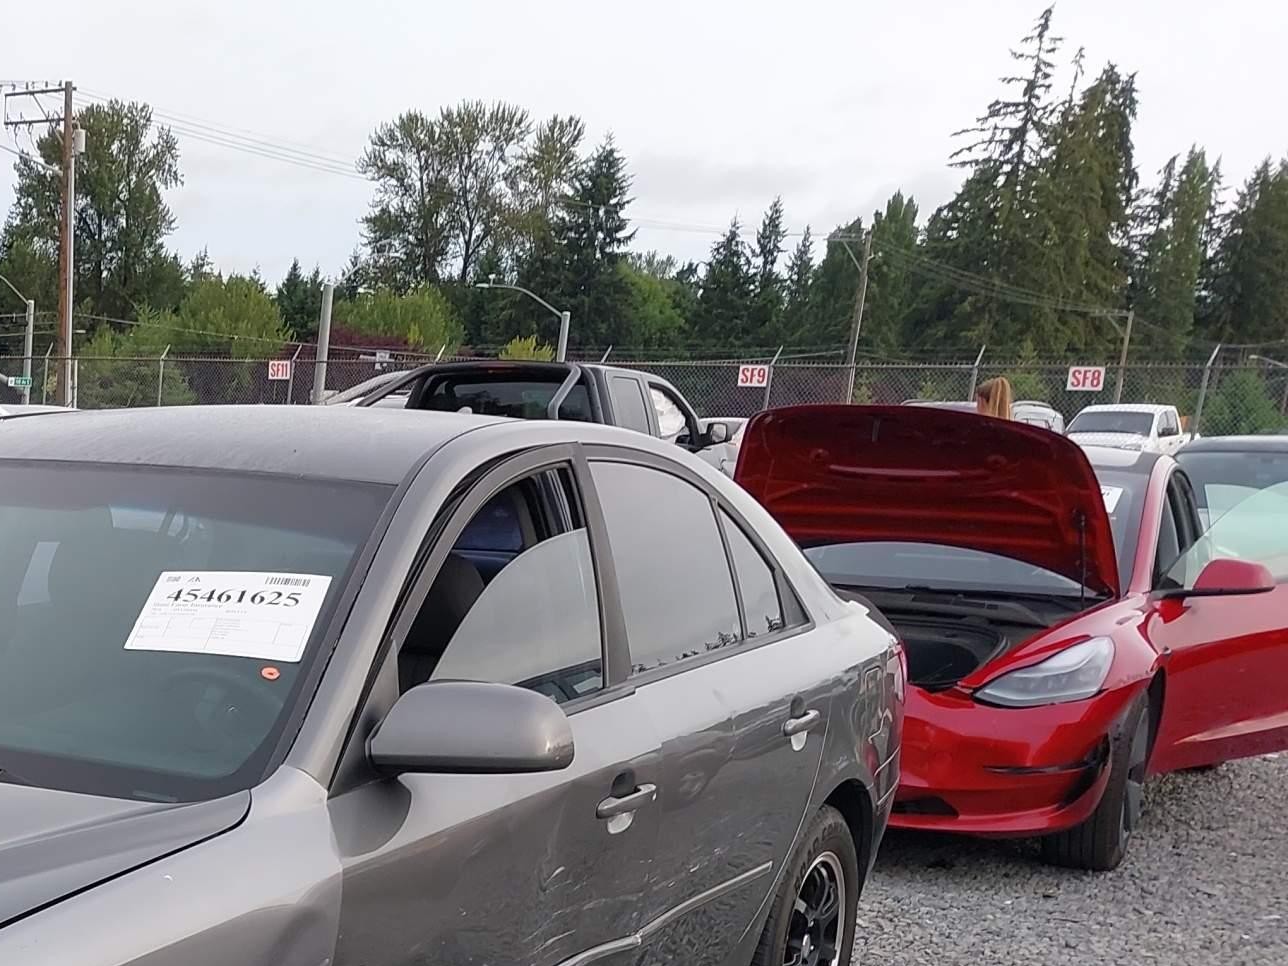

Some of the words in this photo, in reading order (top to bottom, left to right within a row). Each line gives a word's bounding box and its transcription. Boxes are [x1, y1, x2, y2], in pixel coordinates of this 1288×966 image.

[270, 362, 288, 378] SF11
[740, 367, 765, 384] SF9
[1071, 369, 1101, 387] SF8
[166, 589, 302, 607] 45461625
